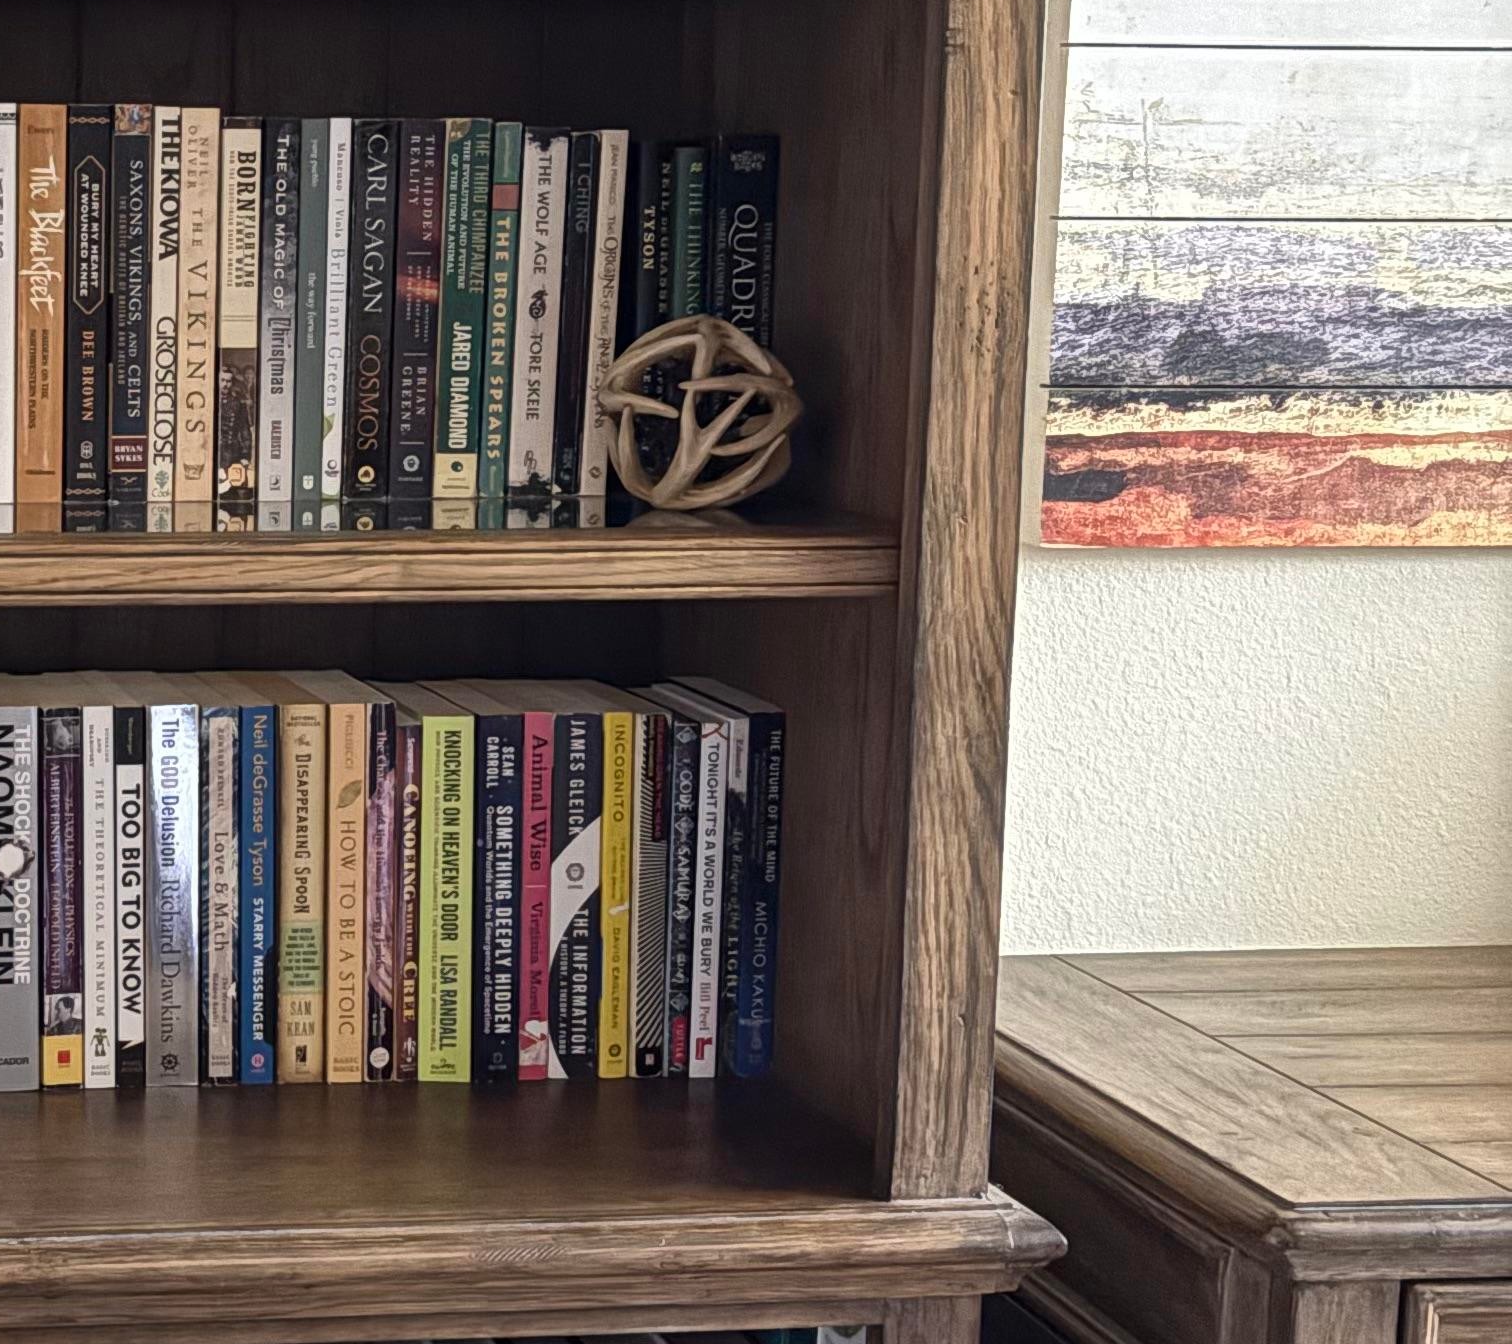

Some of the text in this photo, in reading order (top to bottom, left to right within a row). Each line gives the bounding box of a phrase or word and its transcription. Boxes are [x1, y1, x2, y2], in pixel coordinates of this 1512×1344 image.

[363, 134, 390, 313] CARL SAGAN
[82, 331, 93, 421] DEE BROWN
[153, 316, 176, 466] GROSECLOSE
[186, 262, 208, 434] VIKINGS
[357, 335, 382, 450] COSMOS
[447, 322, 472, 449] JARED DIAMOND
[487, 217, 511, 459] THE BROKEN SPEARS
[525, 333, 543, 421] TORE SKEIE
[160, 719, 179, 867] The GOD Delusion
[529, 735, 548, 871] Animal Wise
[613, 725, 626, 822] INCOGNITO
[13, 724, 31, 985] THE SHOCK DOCTRINE
[121, 784, 141, 1014] TOO BIG TO KNOW
[160, 880, 182, 1042] Richard Dawkins
[251, 898, 264, 1041] STARRY MESSENGER
